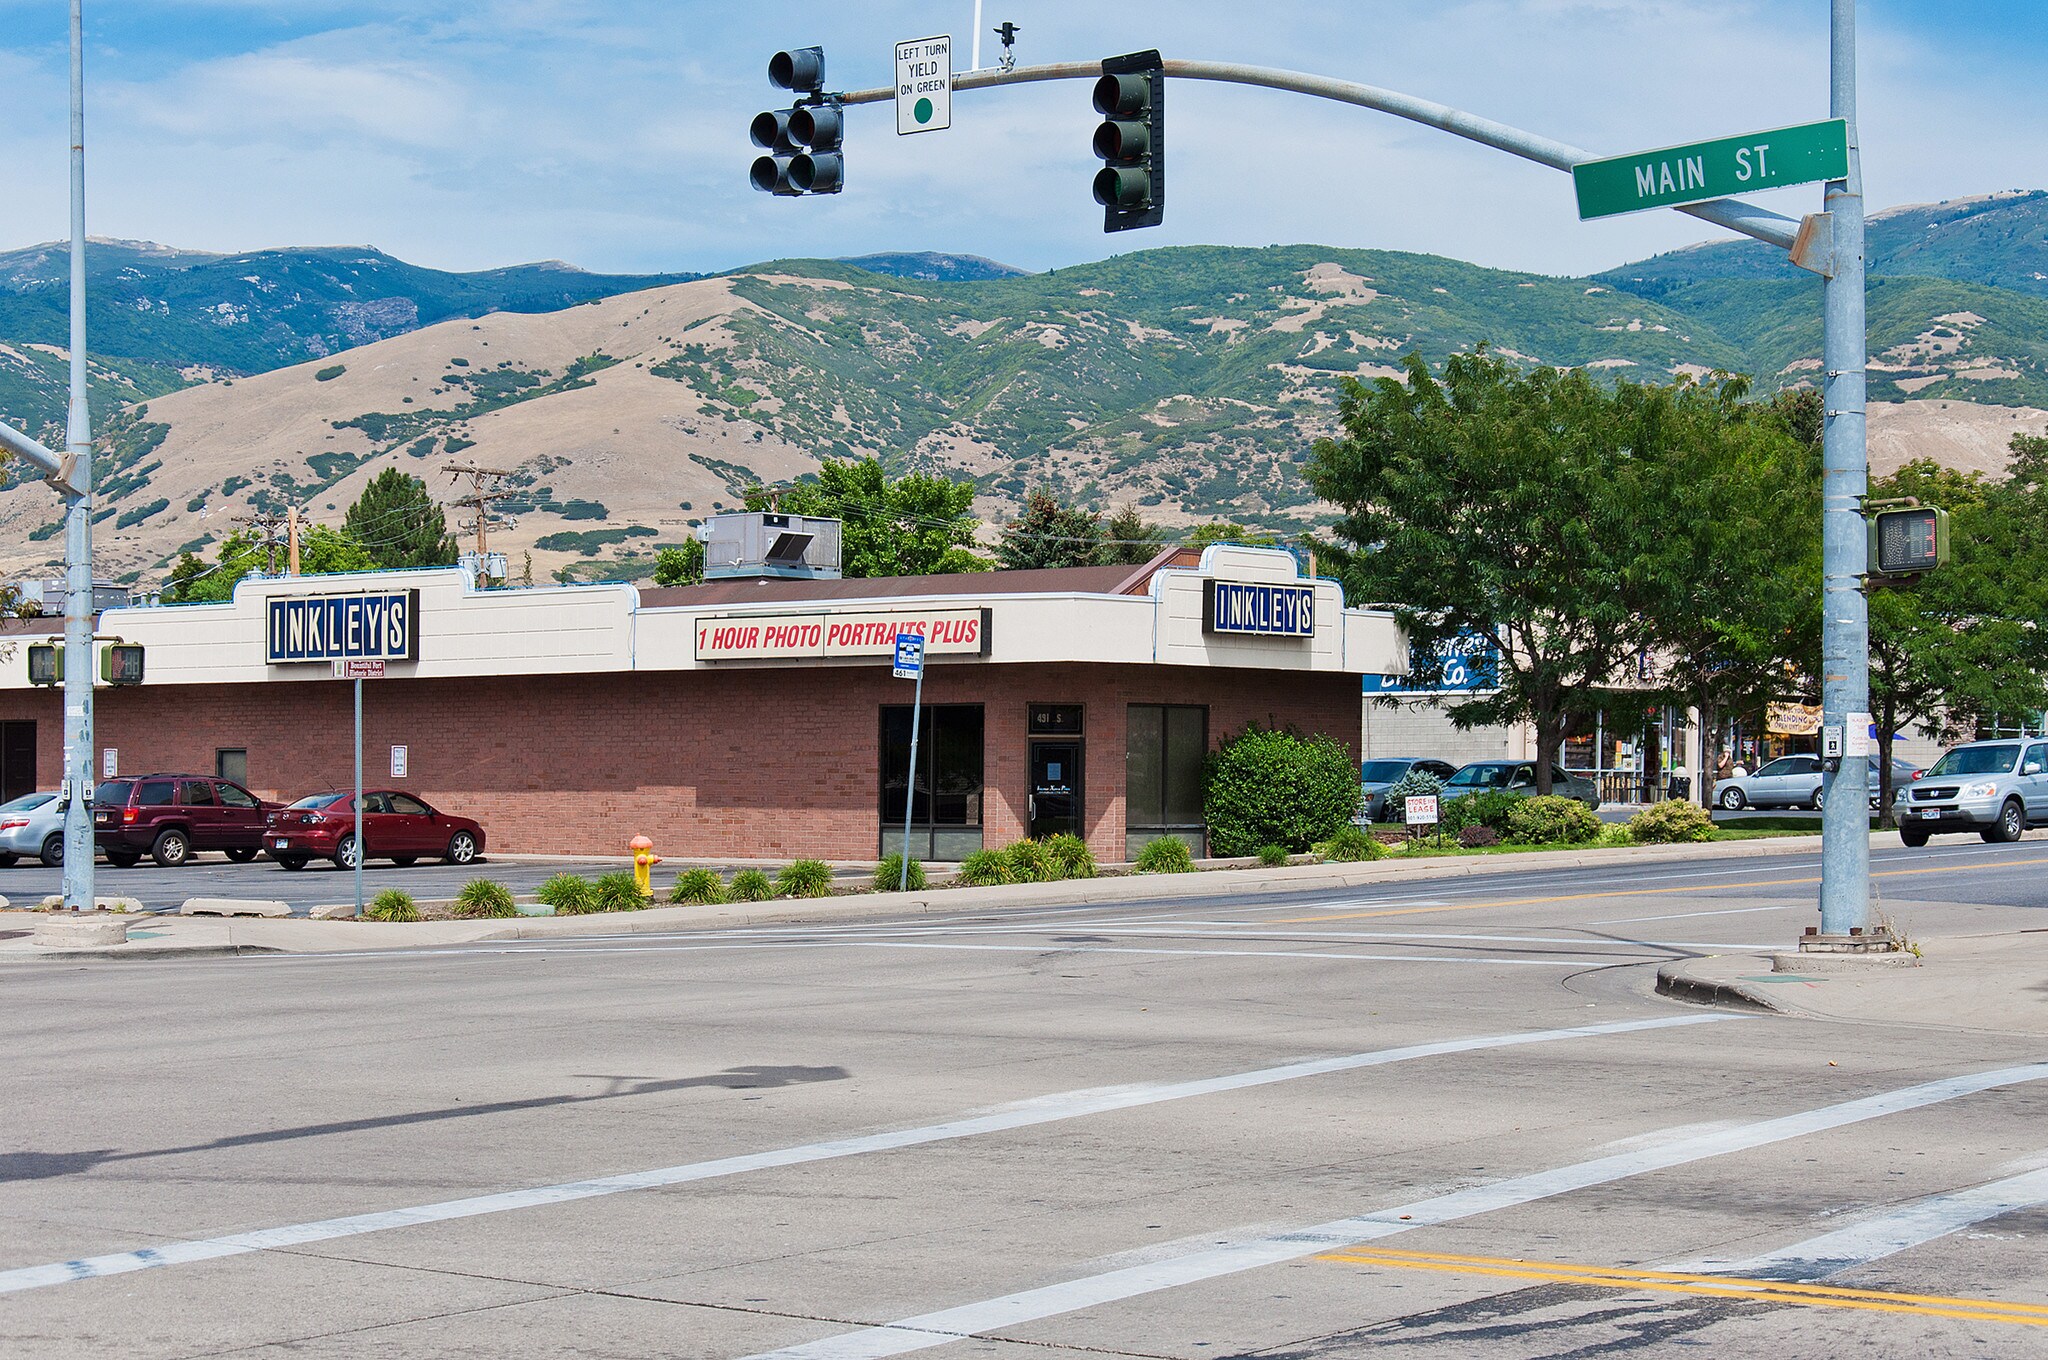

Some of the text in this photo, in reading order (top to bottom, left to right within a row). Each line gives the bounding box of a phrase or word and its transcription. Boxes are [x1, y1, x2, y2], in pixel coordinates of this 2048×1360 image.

[899, 43, 947, 60] LEFT TURN
[908, 61, 938, 78] YIELD
[901, 79, 946, 95] ON GREEN
[1635, 144, 1776, 198] MAIN ST.
[1220, 588, 1311, 629] INKLEY'S
[275, 597, 403, 652] INKLEY'S
[699, 628, 707, 650] 1
[712, 627, 760, 650] HOUR
[763, 624, 821, 648] PHOTO
[930, 619, 979, 644] PLUS
[895, 669, 906, 677] 461
[1442, 658, 1468, 687] Co.
[1407, 798, 1427, 806] STORE
[1409, 805, 1434, 813] LEASE
